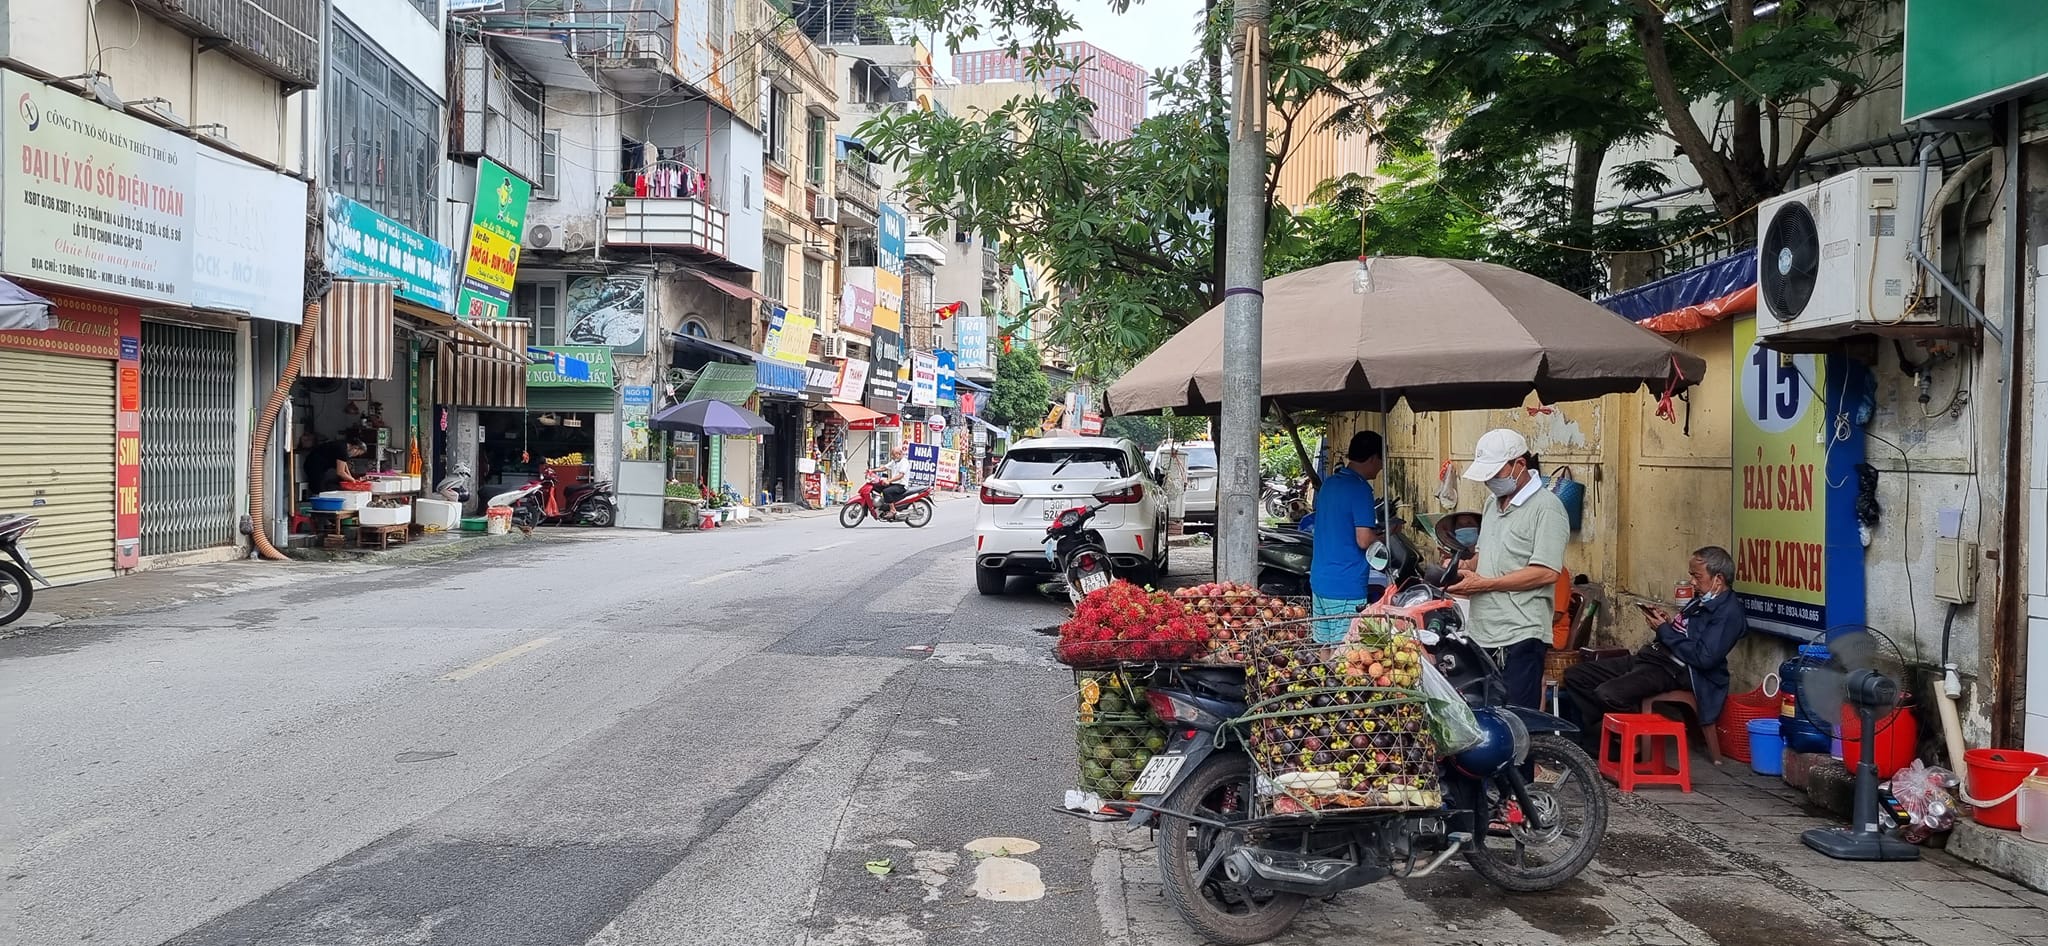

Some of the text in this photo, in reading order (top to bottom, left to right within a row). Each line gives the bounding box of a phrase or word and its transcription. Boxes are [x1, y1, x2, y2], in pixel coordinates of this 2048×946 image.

[46, 109, 71, 131] CÔNG
[73, 118, 83, 137] TY
[129, 137, 151, 159] THIẾT
[167, 151, 178, 168] ĐÔ
[22, 145, 183, 217] ĐẠI LÝ XỔ SỐ ĐIỆN TOÁN
[41, 194, 55, 211] 6/36
[97, 228, 112, 246] CHỌN
[113, 231, 123, 247] CÁC
[884, 211, 900, 242] NHÀ
[363, 233, 379, 263] ĐẠI
[380, 237, 388, 264] LÝ
[389, 240, 402, 270] HẢI
[402, 246, 417, 276] SẢN
[31, 257, 44, 273] ĐỊA
[59, 263, 68, 275] 13
[69, 262, 85, 279] ĐÔNG
[87, 266, 98, 281] TÁC
[102, 273, 113, 286] KIM
[113, 273, 127, 287] LIÊN
[147, 279, 156, 292] ĐA
[159, 281, 167, 294] HÀ
[167, 281, 176, 296] NỘI
[92, 322, 112, 338] NHÀ
[576, 349, 605, 364] QUẢ
[1753, 344, 1800, 422] 15
[120, 437, 138, 466] SIM
[909, 458, 936, 473] THUỐC
[915, 446, 932, 458] NHÀ
[1743, 443, 1813, 513] HẢI SẢN
[120, 476, 138, 516] THẺ
[1735, 537, 1823, 593] ANH MINH
[1750, 598, 1764, 612] ĐÔNG
[1764, 599, 1775, 613] TÁC
